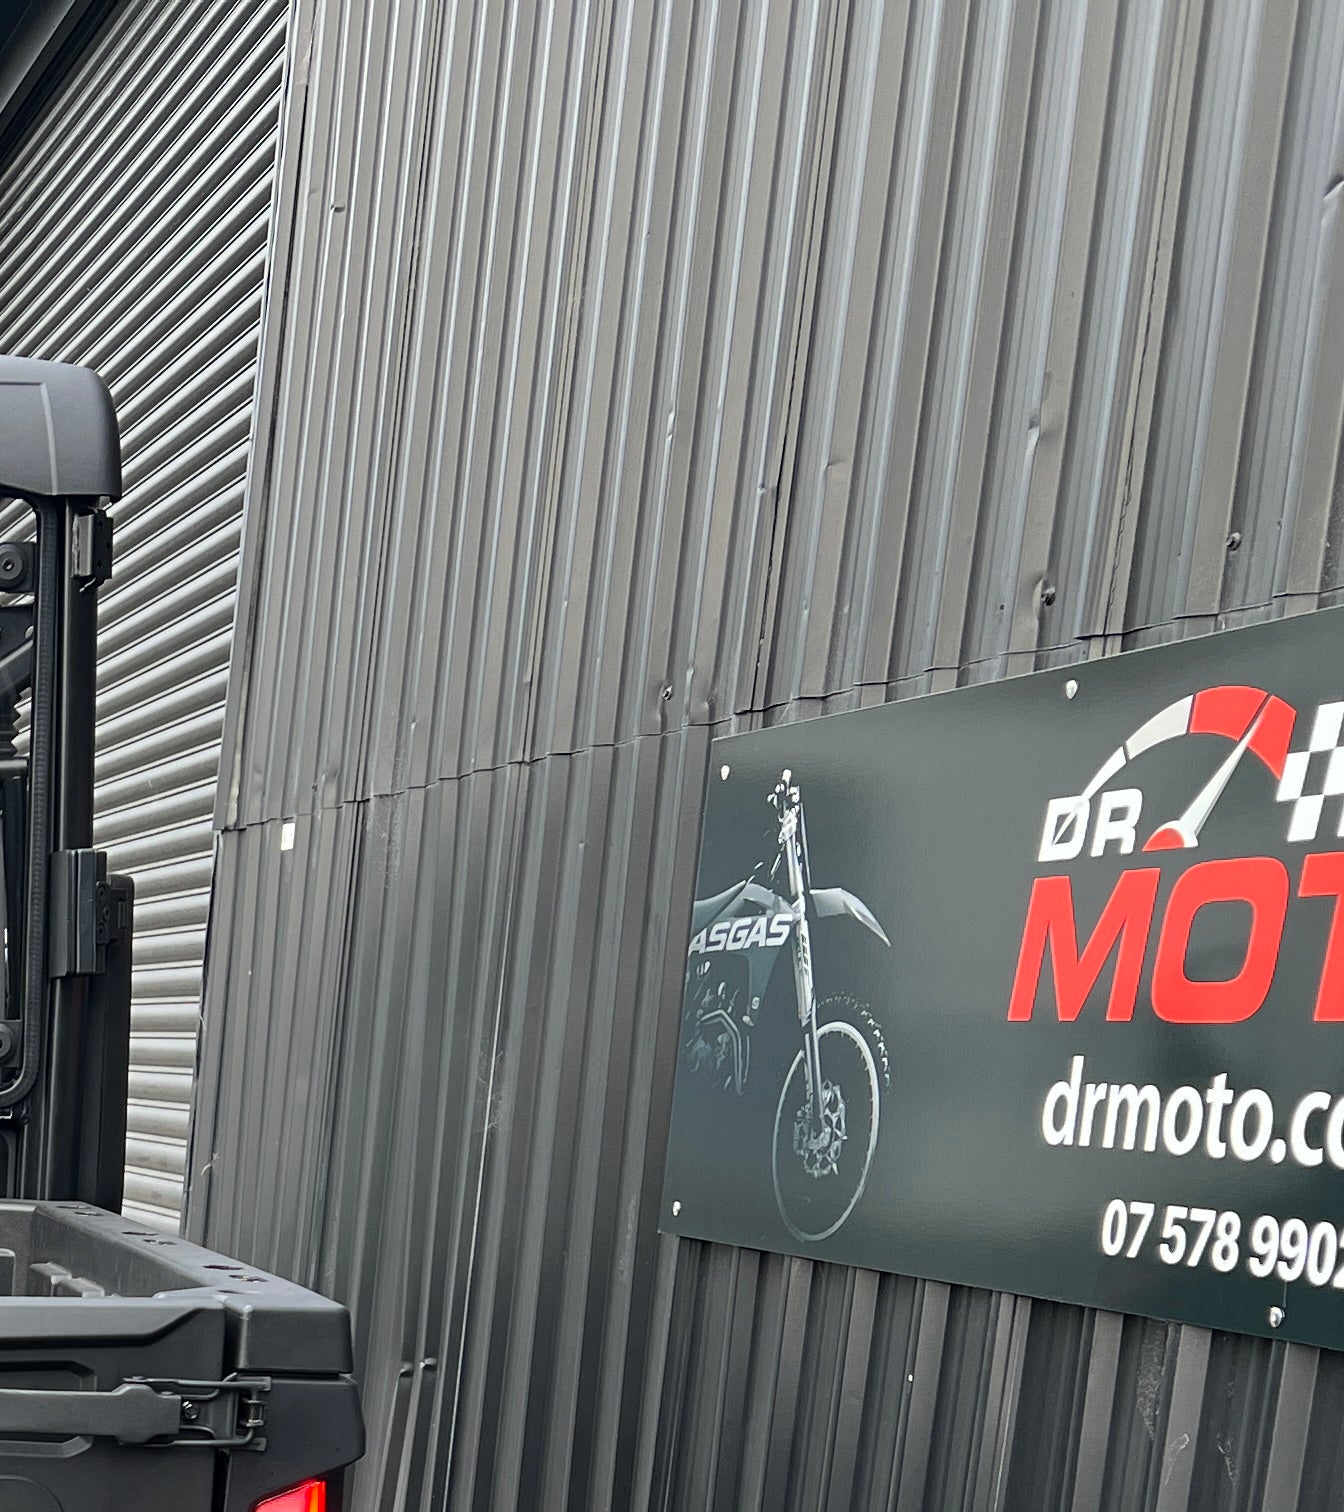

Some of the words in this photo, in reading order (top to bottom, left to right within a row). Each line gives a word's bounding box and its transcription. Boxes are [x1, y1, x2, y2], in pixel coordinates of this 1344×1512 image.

[1038, 787, 1143, 862] DR
[688, 914, 794, 956] ASGAS
[1101, 1199, 1155, 1258] 07
[1159, 1205, 1242, 1273] 578
